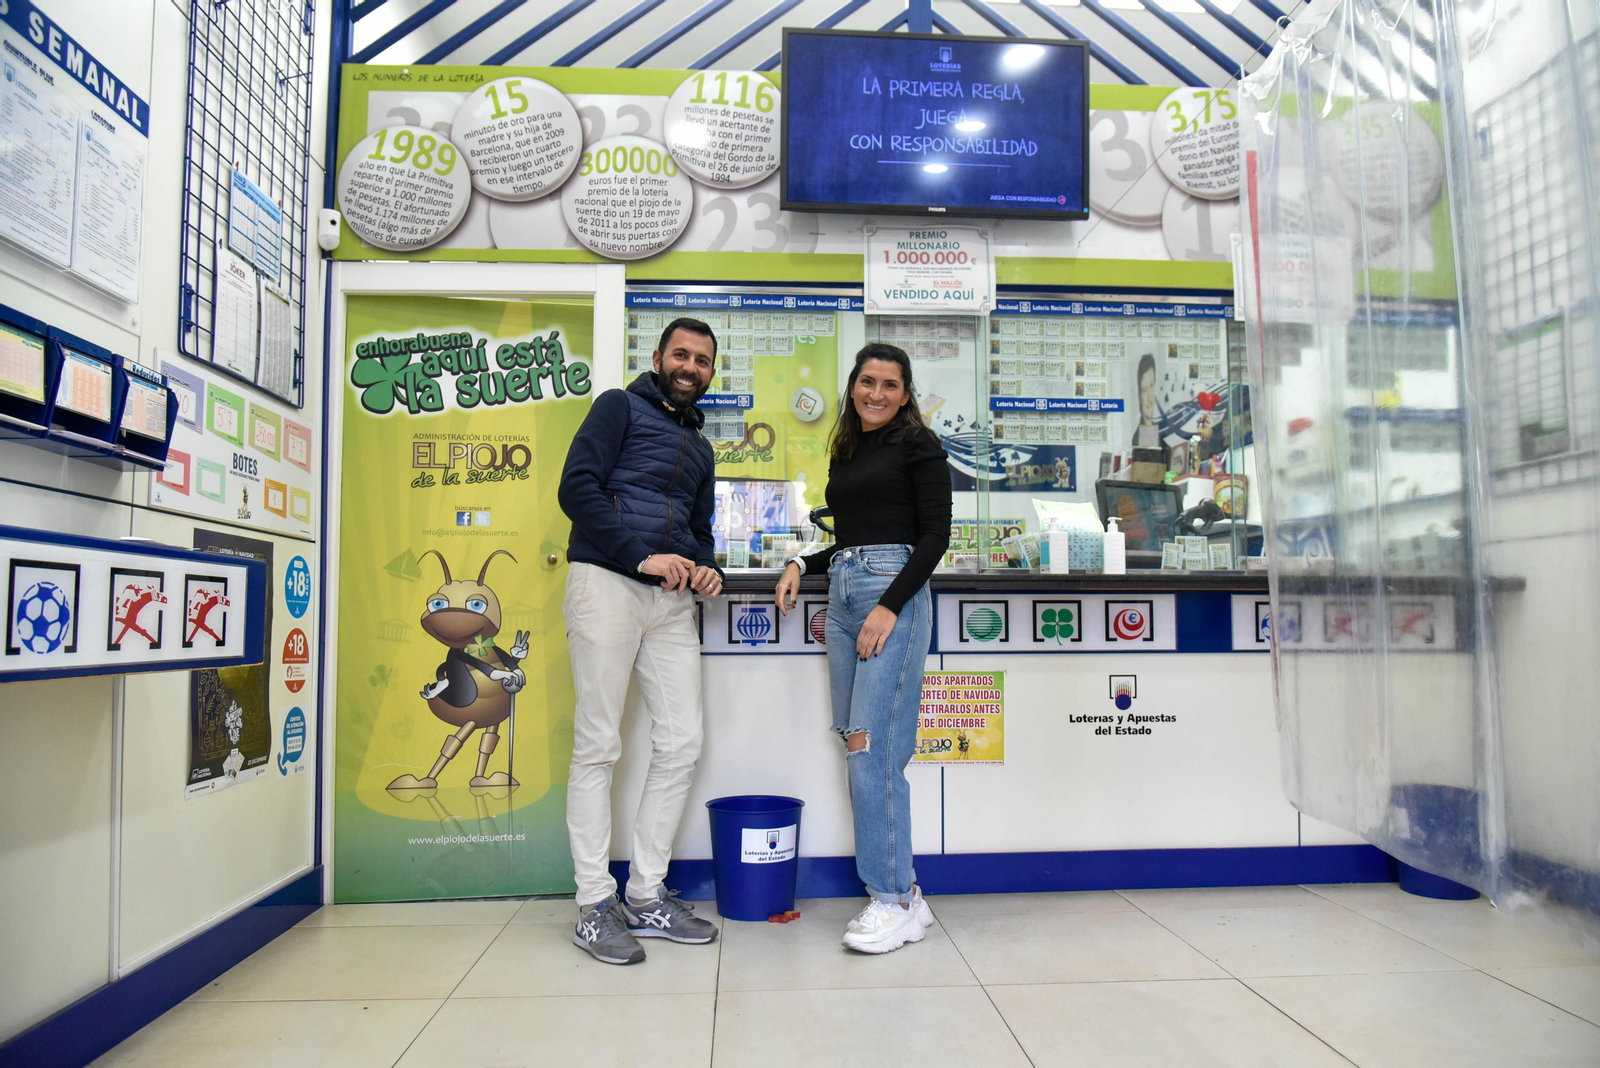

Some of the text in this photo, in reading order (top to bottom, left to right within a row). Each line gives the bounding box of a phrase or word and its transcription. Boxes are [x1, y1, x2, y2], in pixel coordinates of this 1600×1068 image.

[28, 11, 141, 128] SEMANAL
[353, 72, 368, 80] LOS
[418, 74, 428, 82] DE
[434, 73, 444, 81] LA
[485, 80, 529, 120] 15
[690, 72, 774, 113] 1116
[863, 77, 1025, 104] LA PRIMERA REGLA,
[915, 108, 968, 129] JUEGA
[1166, 90, 1237, 134] 3,75
[464, 110, 562, 139] minutos de oro para una
[478, 133, 504, 145] madre
[507, 132, 511, 140] y
[525, 124, 540, 135] hija
[542, 122, 552, 130] de
[368, 129, 456, 176] 1989
[470, 143, 513, 157] Barcelona,
[516, 139, 531, 149] que
[545, 127, 565, 140] 2009
[480, 141, 561, 165] recibieron un cuarto
[850, 135, 1038, 156] CON RESPONSABILIDAD
[471, 144, 574, 176] premio y luego un tercero
[579, 146, 679, 177] 300000
[1183, 154, 1235, 172] ganador belga
[359, 161, 374, 169] año
[389, 166, 405, 177] que
[407, 169, 416, 178] La
[419, 172, 453, 189] Primitiva
[487, 160, 564, 184] en ese intervalo de
[589, 175, 668, 186] euros fue el primer
[710, 173, 733, 183] 1994.
[350, 179, 383, 193] superior
[392, 189, 416, 201] 1.000
[418, 195, 452, 208] millones
[354, 169, 453, 199] reparte el primer premio
[513, 180, 545, 193] tiempo.
[588, 186, 668, 197] premio de la lotería
[344, 195, 448, 226] se llevó 1.174 millones de
[348, 186, 449, 217] de pesetas. El afortunado
[347, 207, 439, 235] pesetas (algo más de 7
[351, 220, 428, 245] millones de euros).
[897, 241, 960, 250] MILLONARIO
[910, 231, 947, 239] PREMIO
[884, 250, 968, 265] 1.000.000
[230, 263, 245, 278] JOKER
[884, 288, 974, 300] VENDIDO AQUÍ
[356, 332, 473, 357] enhorabuena
[421, 331, 565, 378] aquí está
[132, 364, 160, 384] Reducidos
[405, 362, 592, 414] la suerte
[233, 452, 258, 476] BOTES
[413, 442, 532, 470] EL PIOJO
[715, 444, 773, 465] uerte
[411, 464, 529, 488] de la suerte
[1006, 465, 1056, 478] EL PIOJO
[422, 529, 519, 537] info@elpiojodelasuerte.es
[287, 570, 306, 597] +18
[288, 634, 304, 655] +18
[945, 676, 993, 686] APARTADOS
[921, 690, 1001, 699] ORTEO DE NAVIDAD
[920, 704, 1000, 713] RETIRARLOS ANTES
[1117, 715, 1123, 725] y
[1127, 714, 1176, 725] Apuestas
[925, 719, 985, 728] DE DICIEMBRE
[1095, 726, 1152, 735] del Estado
[408, 833, 525, 845] www.elpiojodelasuerte.es
